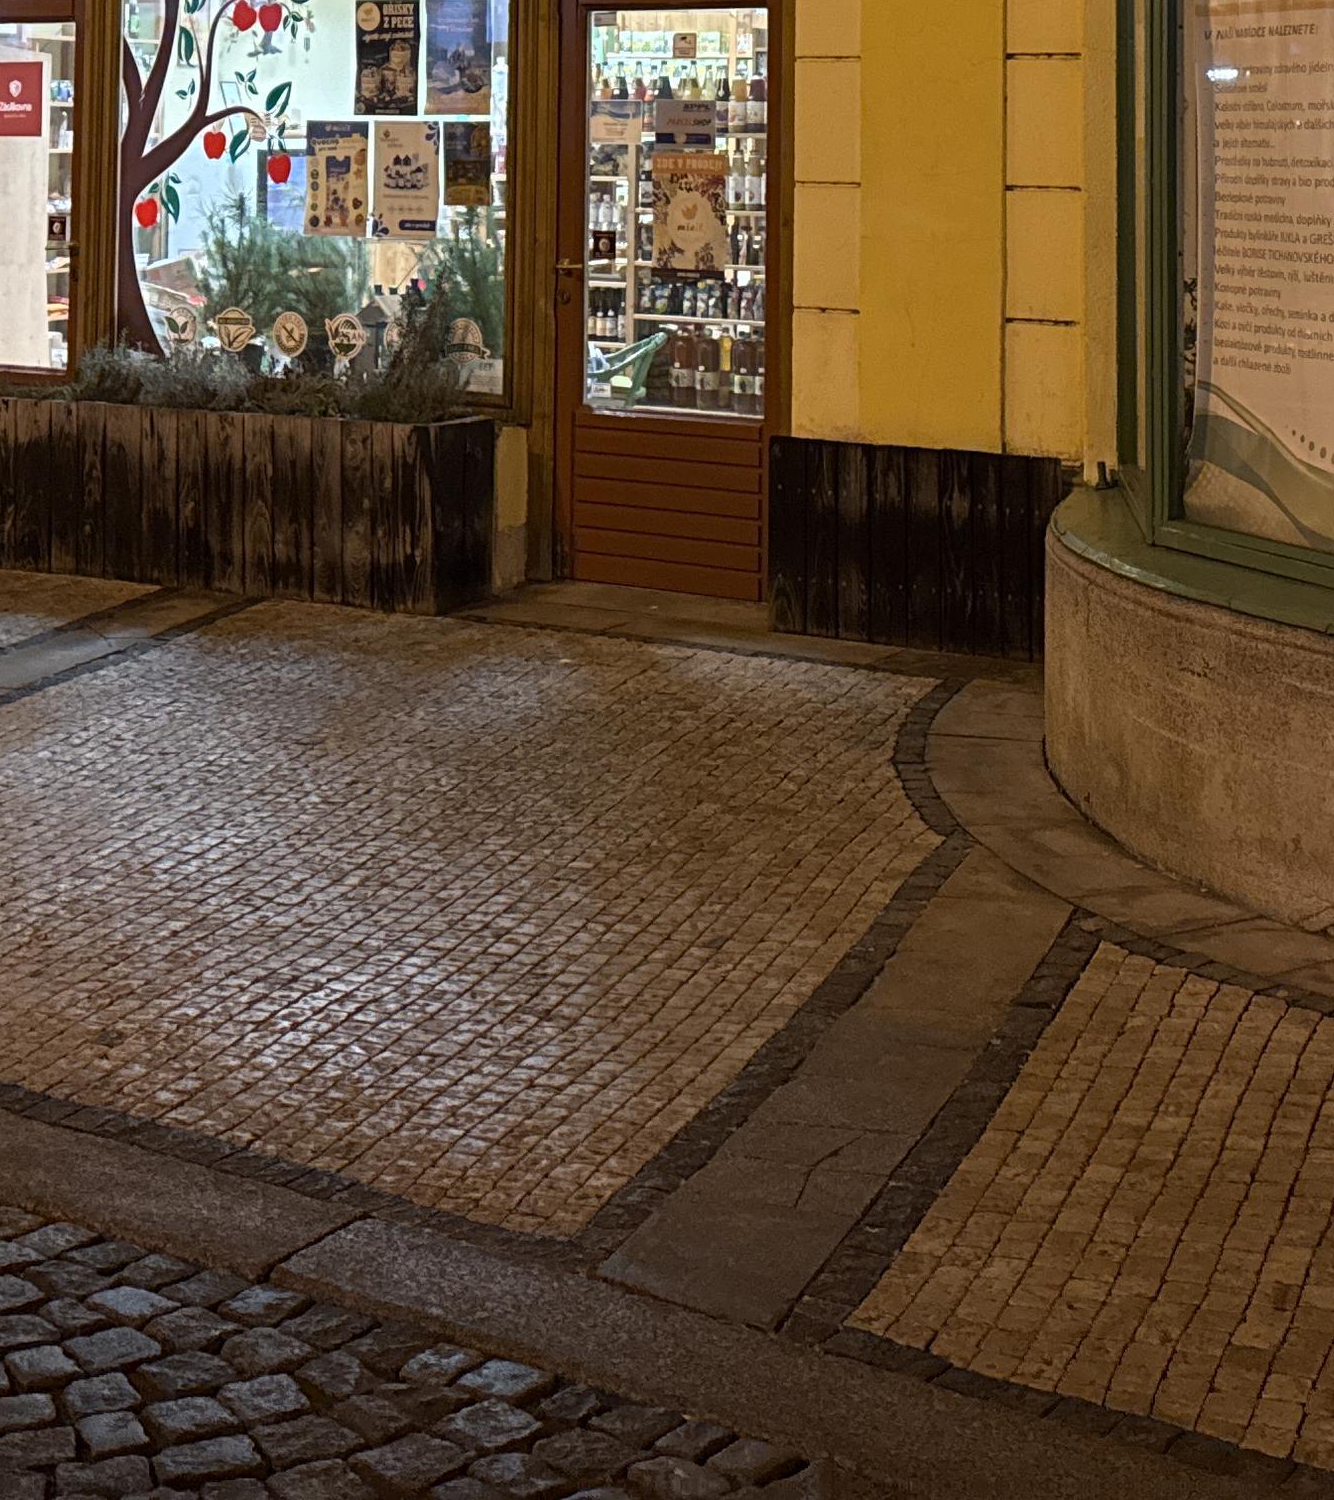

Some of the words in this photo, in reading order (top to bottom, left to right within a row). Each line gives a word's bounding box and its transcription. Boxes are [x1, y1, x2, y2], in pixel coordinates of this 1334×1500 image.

[1269, 23, 1315, 38] NALEZNETE
[1299, 174, 1313, 187] bio
[1296, 212, 1331, 228] doplňky
[1320, 312, 1327, 323] a
[1254, 323, 1286, 339] produkty
[1287, 326, 1296, 339] od
